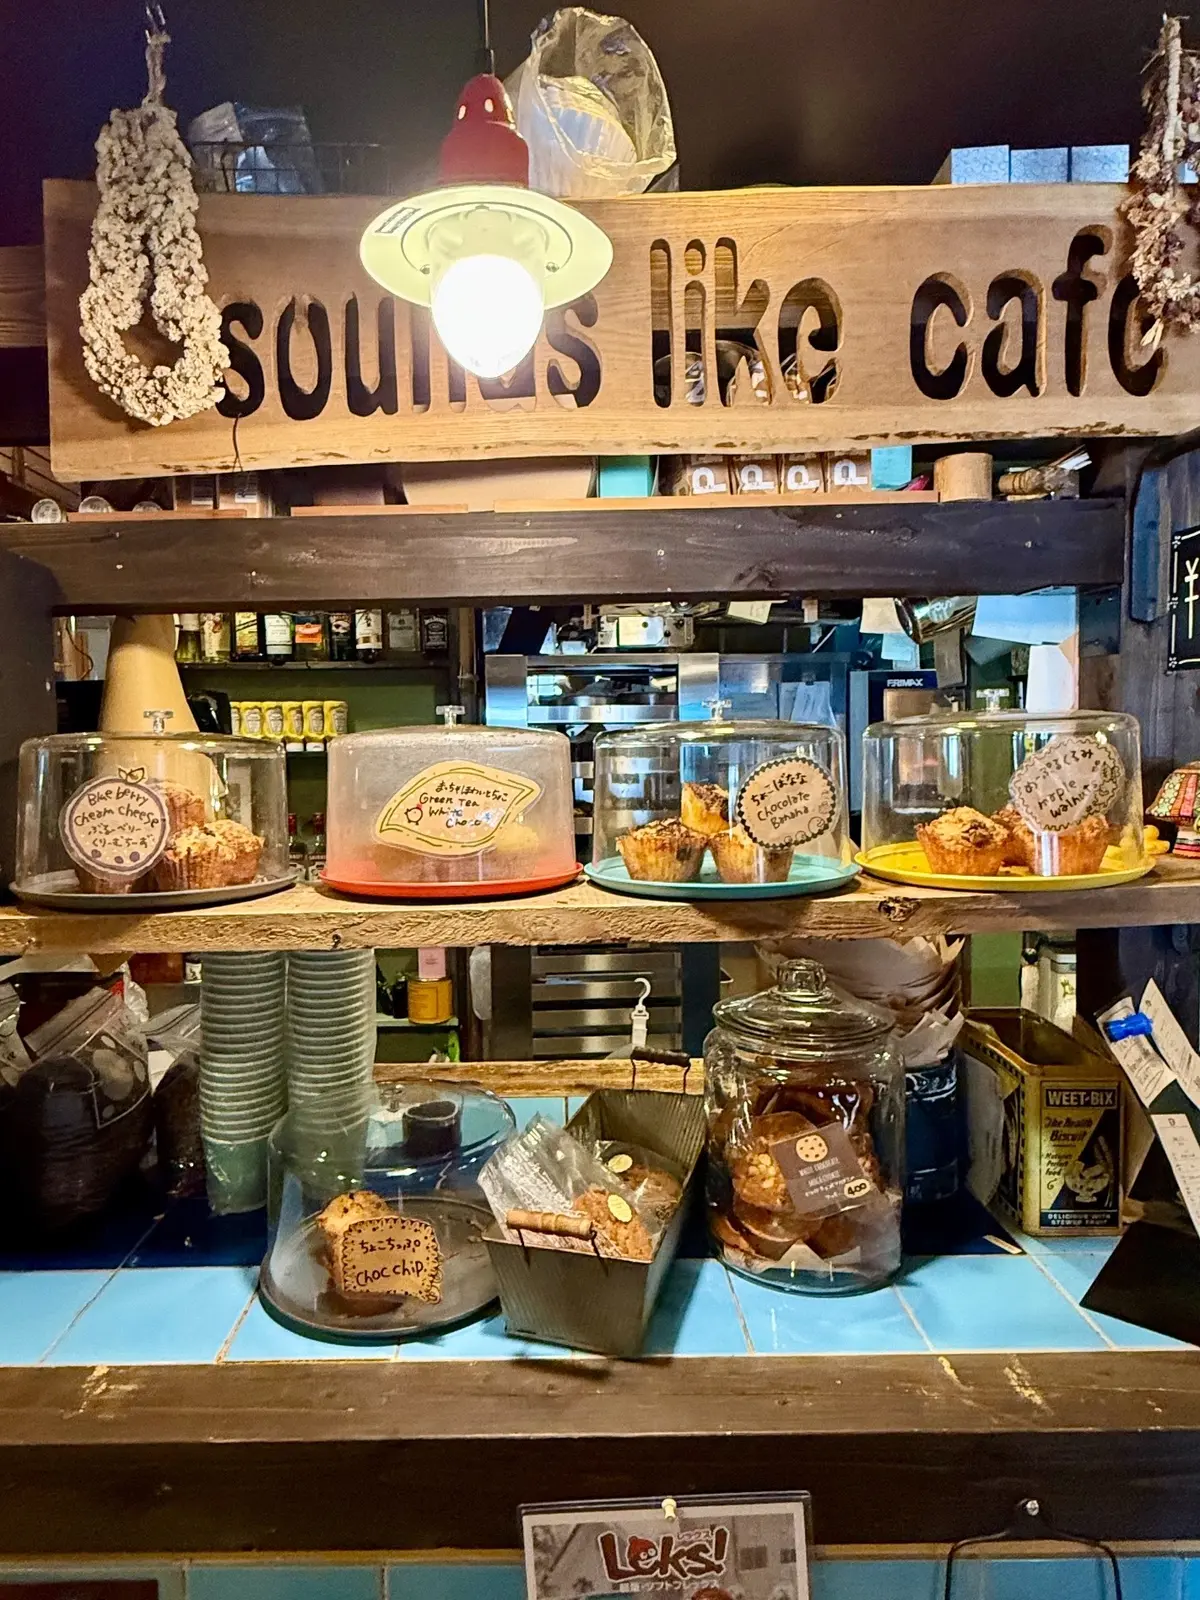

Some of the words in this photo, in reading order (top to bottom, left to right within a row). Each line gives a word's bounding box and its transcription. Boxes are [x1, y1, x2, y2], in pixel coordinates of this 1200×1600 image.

[650, 236, 844, 409] like
[419, 792, 453, 805] Green
[458, 798, 481, 807] Tea
[757, 791, 811, 822] Chocolate
[428, 806, 463, 818] White
[1047, 1090, 1114, 1106] WEET-BIX
[847, 1182, 867, 1196] 400
